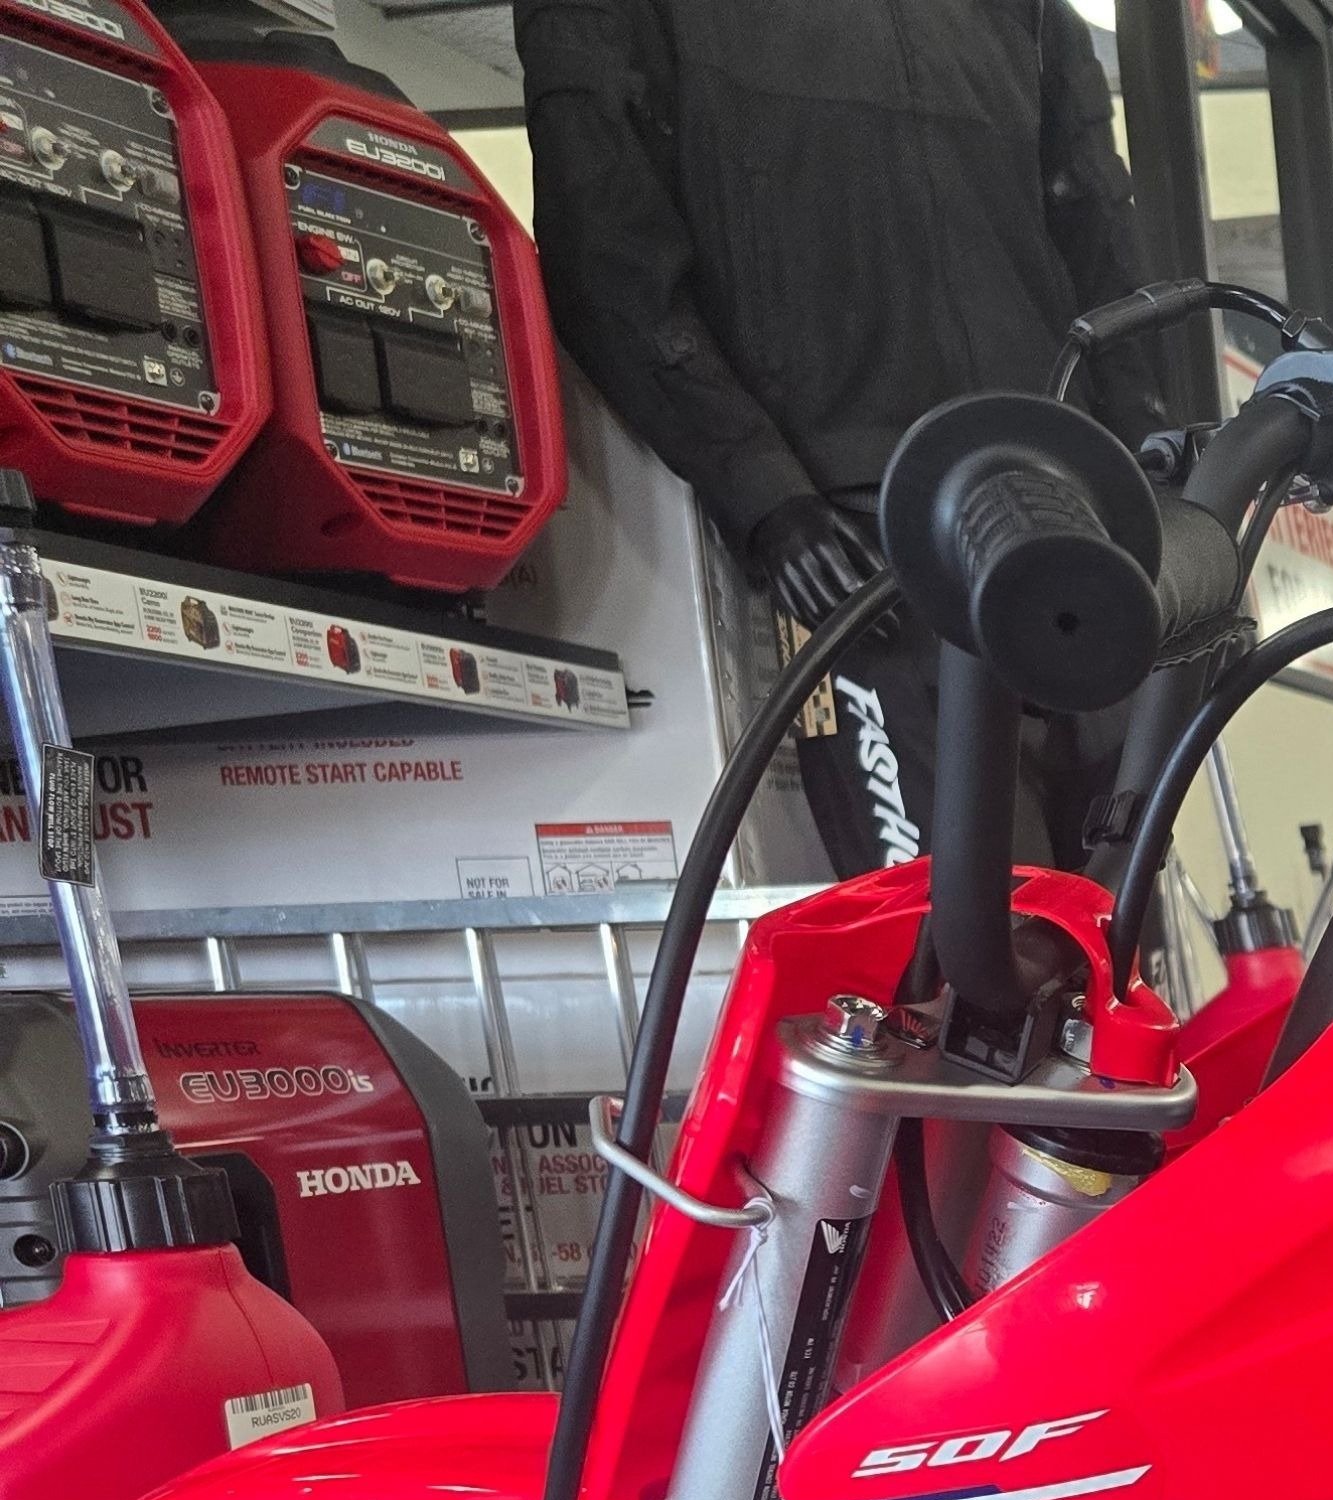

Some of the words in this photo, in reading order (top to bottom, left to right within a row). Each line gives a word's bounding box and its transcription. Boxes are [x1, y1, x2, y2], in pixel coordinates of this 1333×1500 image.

[220, 764, 301, 786] REMOTE
[306, 762, 368, 785] START
[373, 760, 464, 781] CAPABLE
[466, 877, 487, 888] NOT
[489, 877, 509, 888] FOR
[180, 1064, 374, 1104] EU3000is
[296, 1161, 421, 1198] HONDA
[850, 1409, 1111, 1479] 50F
